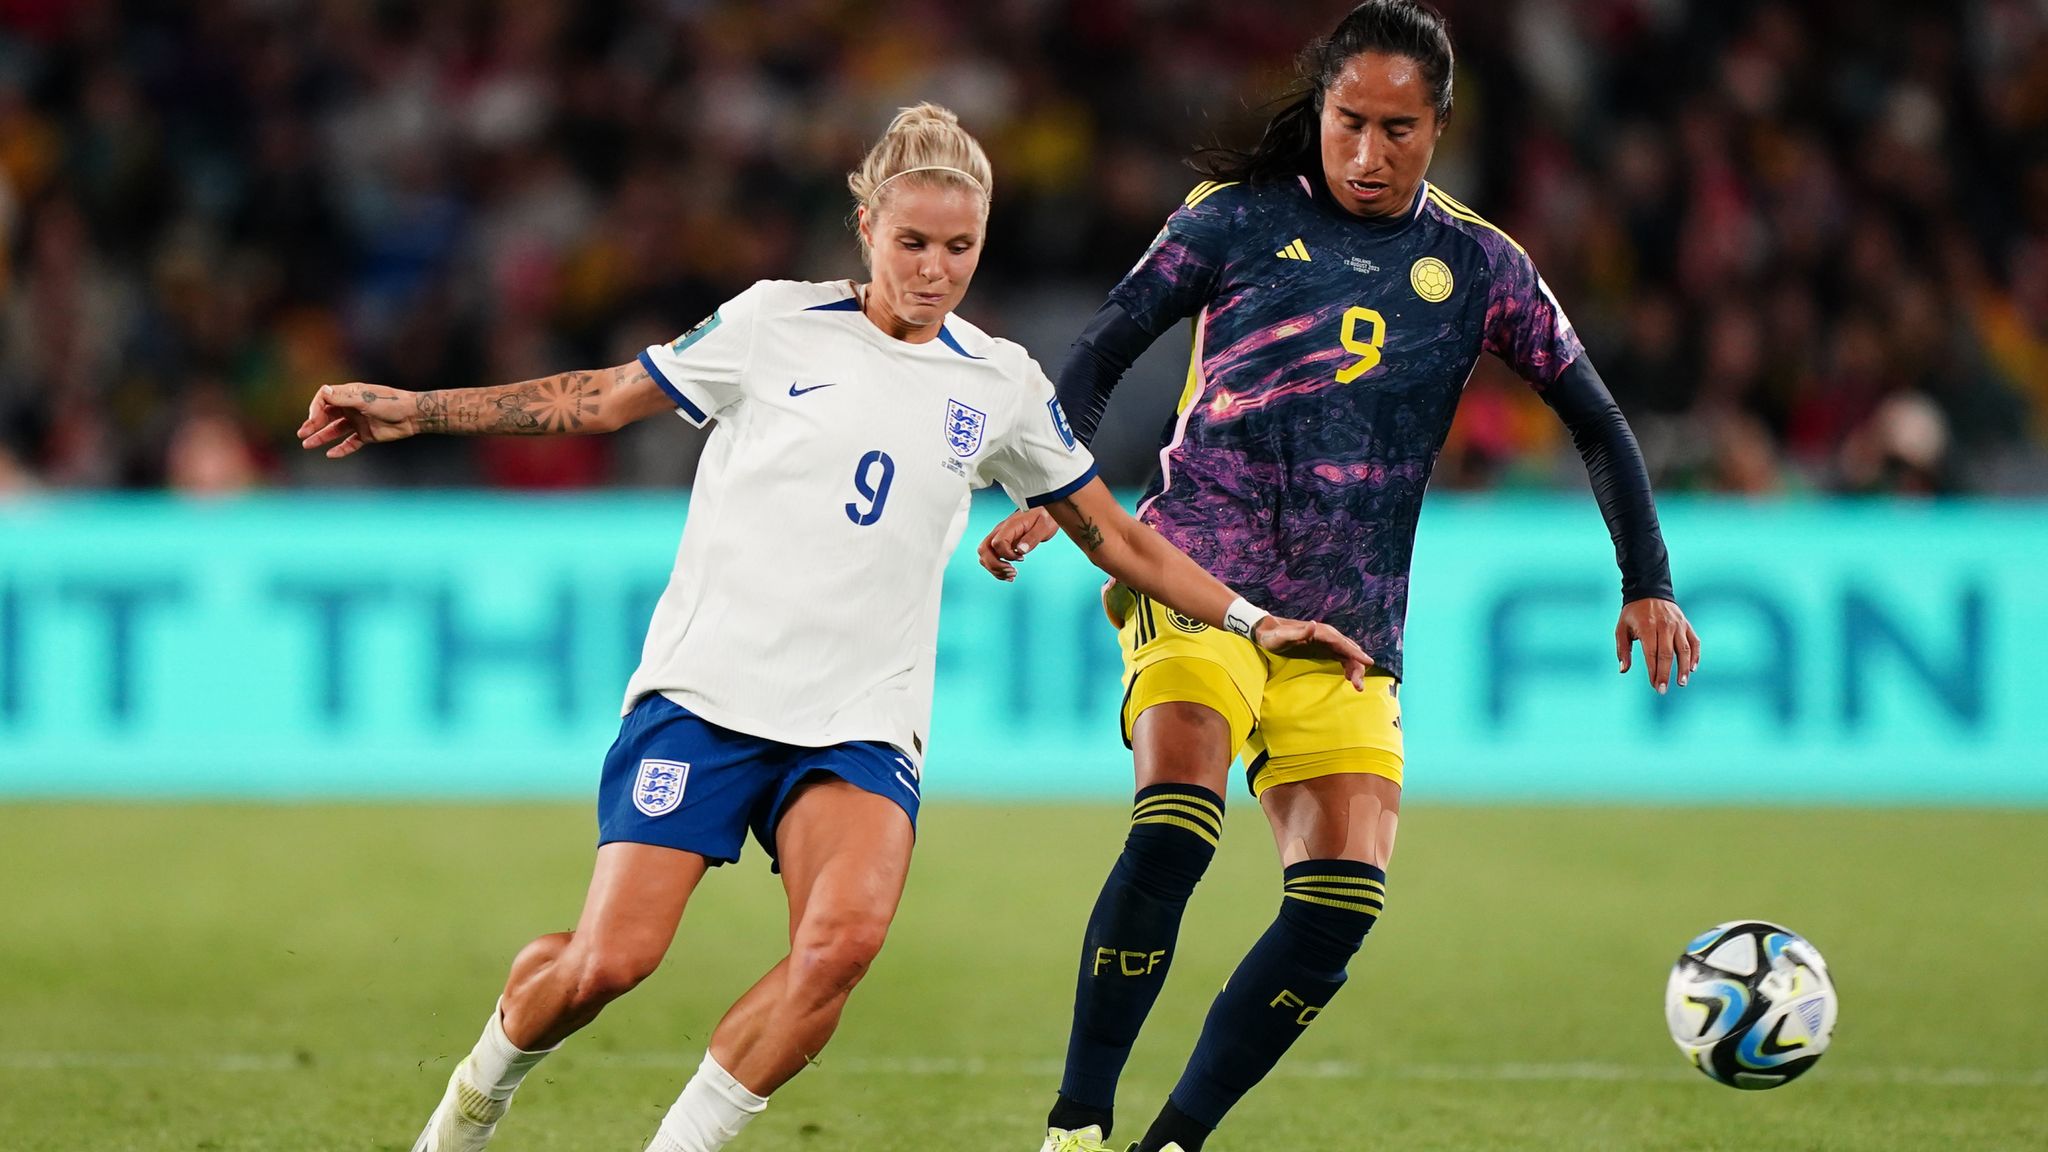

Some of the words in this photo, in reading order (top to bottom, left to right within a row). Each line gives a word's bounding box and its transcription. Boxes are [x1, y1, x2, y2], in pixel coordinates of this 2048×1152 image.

[1335, 306, 1386, 384] 9
[845, 450, 895, 526] 9
[1486, 574, 1987, 728] FAN
[1093, 946, 1166, 976] FCF
